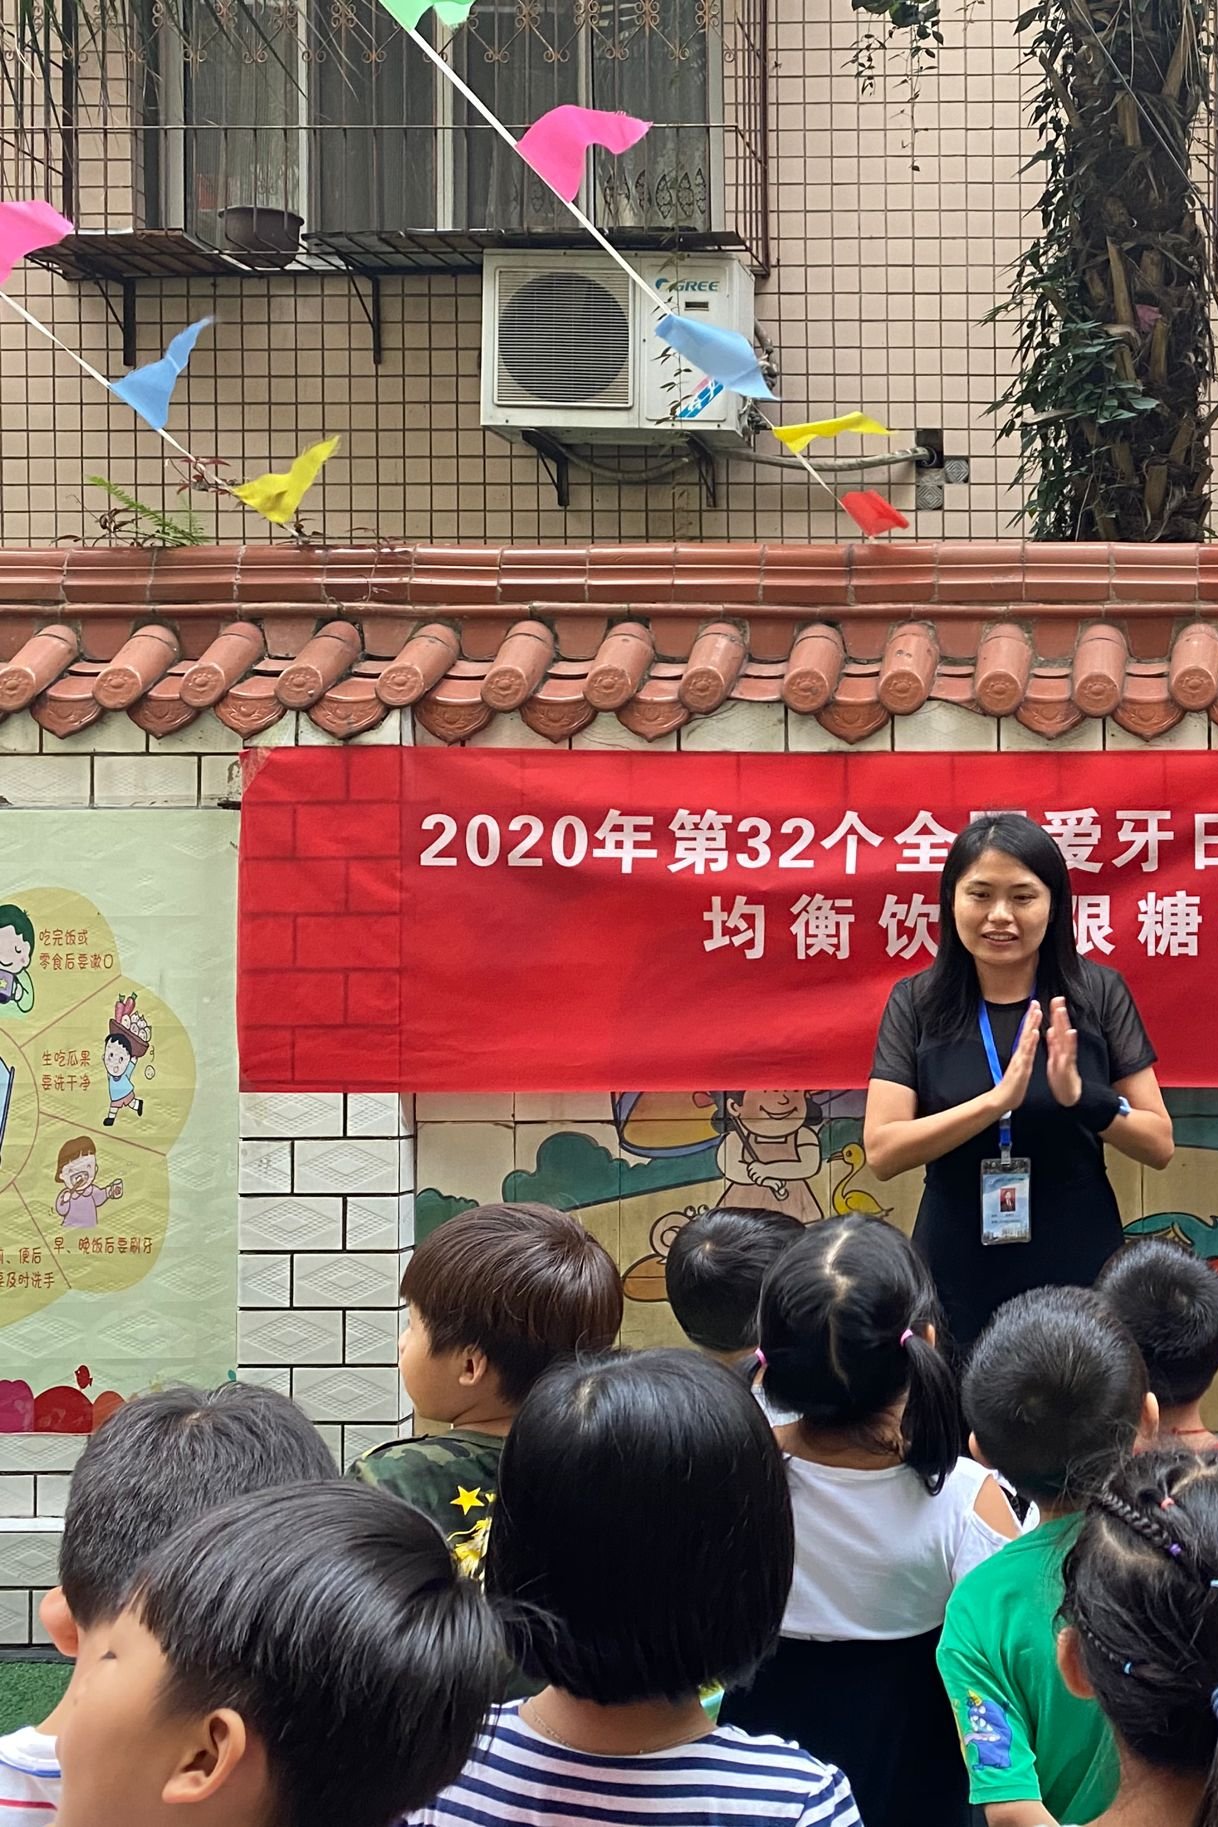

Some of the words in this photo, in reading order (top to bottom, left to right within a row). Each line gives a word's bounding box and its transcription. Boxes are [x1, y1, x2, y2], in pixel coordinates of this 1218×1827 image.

[675, 280, 720, 292] GREE
[39, 928, 89, 946] 吃完饭或
[39, 952, 114, 970] 零食后要漱口
[42, 1050, 91, 1067] 生吃瓜果
[42, 1074, 91, 1091] 要洗干净
[54, 1236, 153, 1254] 早、晚饭后要刷牙
